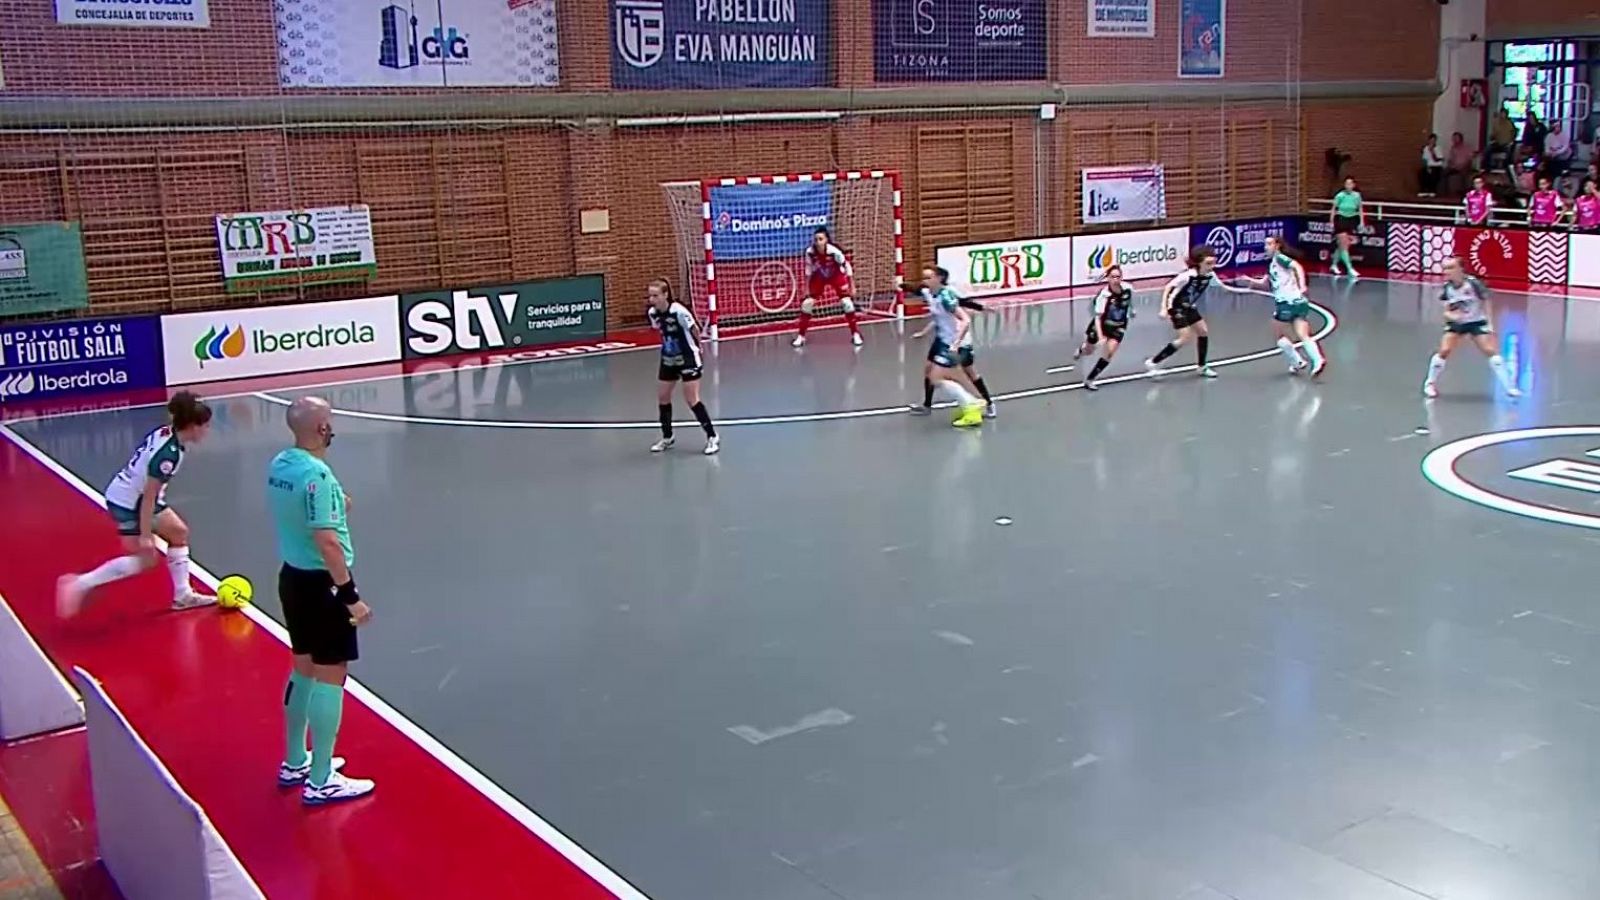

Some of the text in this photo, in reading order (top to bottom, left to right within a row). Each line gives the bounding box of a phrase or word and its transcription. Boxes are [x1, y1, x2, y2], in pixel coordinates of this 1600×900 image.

[135, 11, 148, 20] DE
[149, 12, 194, 21] DEPORTES
[979, 4, 1022, 20] Somos
[975, 21, 1025, 39] deporte
[675, 29, 815, 62] EVA MANGUÁN
[893, 54, 949, 67] TIZONA
[732, 213, 827, 232] Domino's Pizza
[220, 213, 316, 256] MRB
[1116, 245, 1177, 265] Iberdrola
[968, 244, 1045, 289] MRB
[527, 301, 602, 317] Servicios para tu
[407, 290, 519, 354] stv
[528, 315, 582, 330] tranquilidad
[16, 323, 122, 341] DIVISIÓN
[253, 321, 374, 353] Iberdrola
[16, 334, 125, 364] FÚTBOL SALA
[39, 368, 128, 392] Iberdrola
